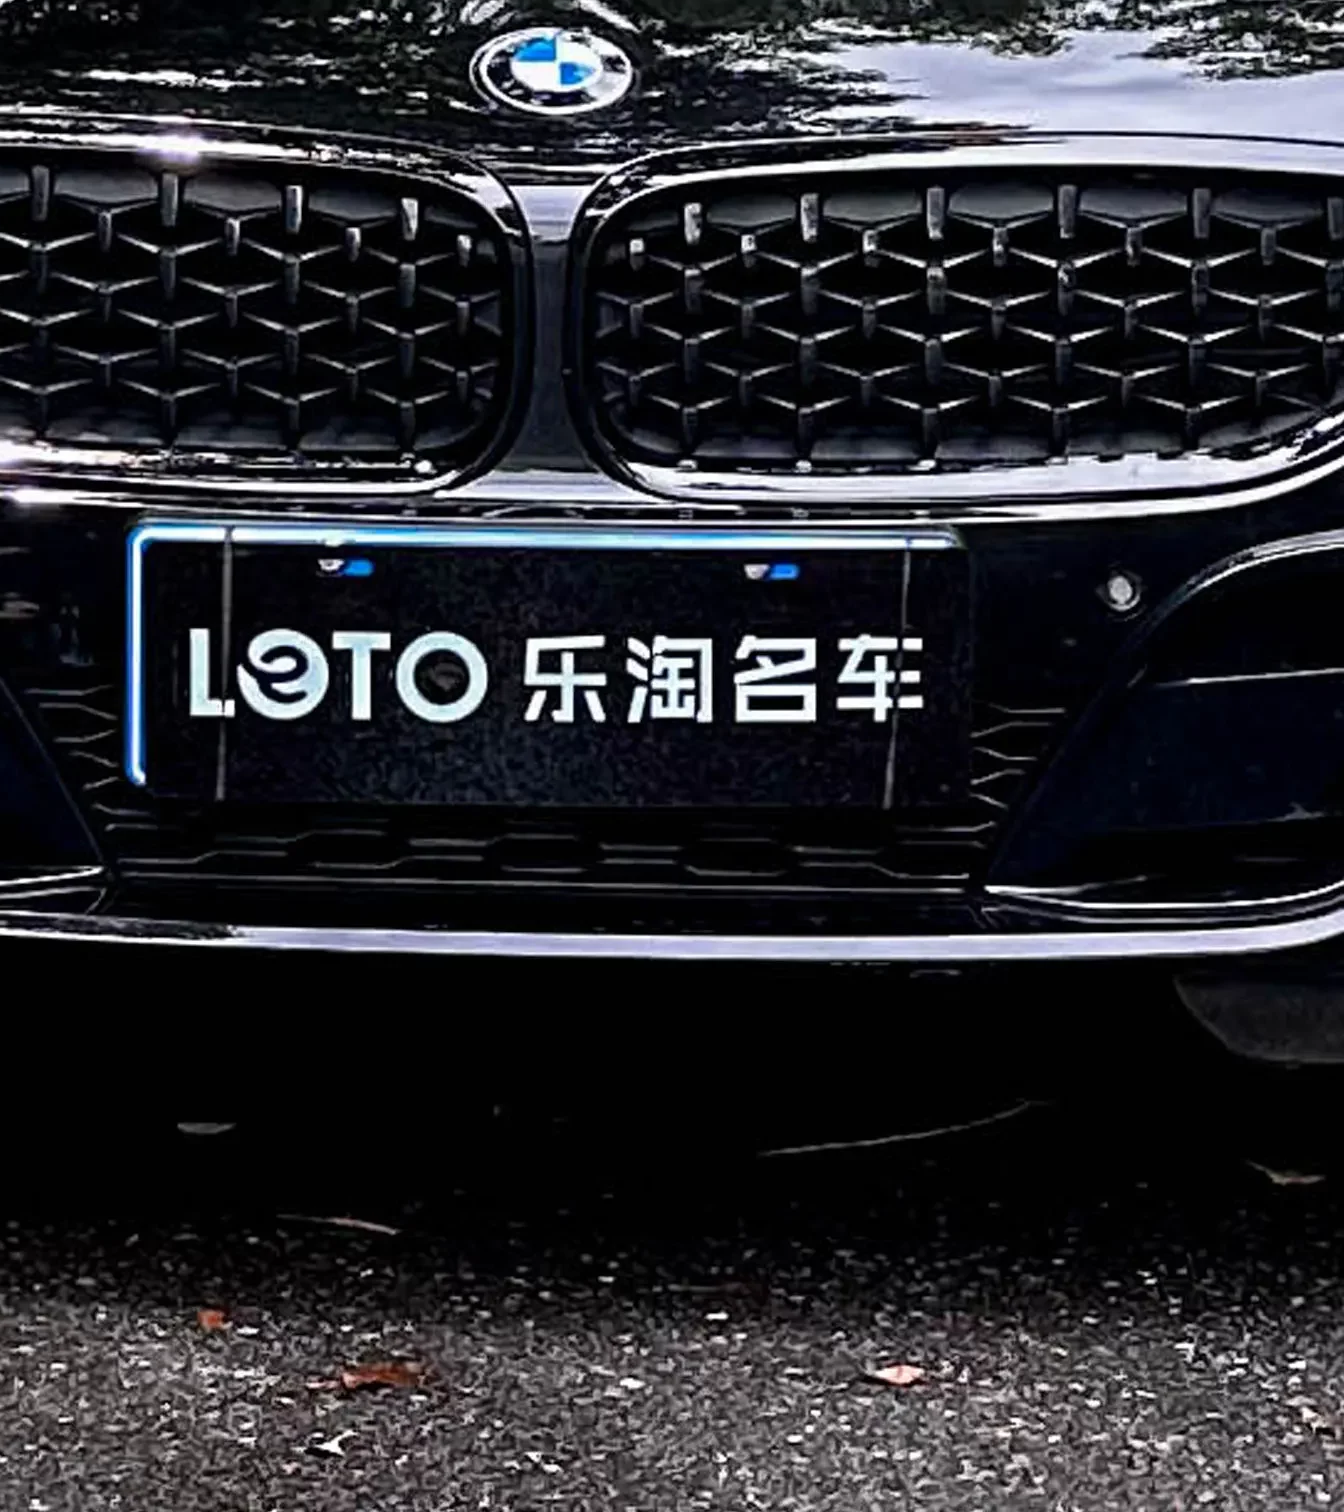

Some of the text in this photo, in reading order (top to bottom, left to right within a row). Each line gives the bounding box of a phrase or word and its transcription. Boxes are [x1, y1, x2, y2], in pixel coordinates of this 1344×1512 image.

[189, 628, 488, 722] LOTO
[523, 634, 924, 723] 乐淘名车
